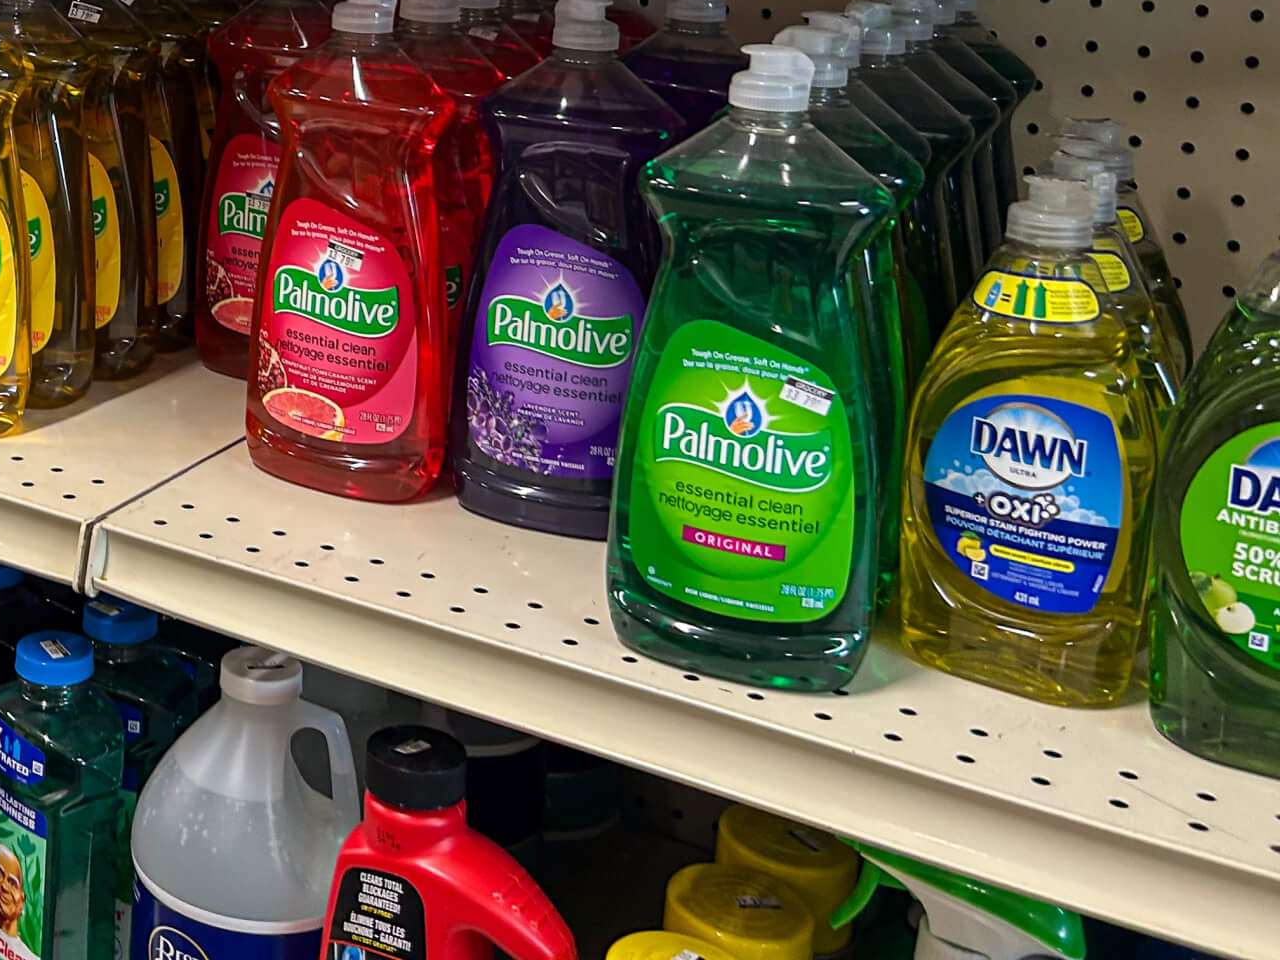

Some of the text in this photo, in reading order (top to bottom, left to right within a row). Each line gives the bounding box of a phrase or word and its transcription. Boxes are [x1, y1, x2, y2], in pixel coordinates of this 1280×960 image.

[278, 273, 396, 327] Palmolive
[286, 328, 376, 356] essential clean
[494, 303, 629, 355] Palmolive
[277, 338, 389, 373] nettoyage essentiel
[713, 351, 781, 368] On Soft On
[504, 361, 608, 387] essential clean
[553, 386, 622, 404] essentiel
[662, 411, 828, 478] Palmolive
[971, 418, 1086, 476] DAWN
[1010, 466, 1038, 479] ULTRA
[659, 491, 820, 534] nettoyage essentiel
[675, 480, 803, 516] essential clean
[990, 495, 1041, 524] OXI
[944, 505, 1066, 544] SUPERIOR STAIN FIGHTING
[944, 515, 1045, 549] POUVOIR DÉTACHANT
[694, 531, 773, 558] ORIGINAL
[5, 789, 37, 820] LASTING
[359, 871, 404, 894] CLEARS TOTAL
[362, 883, 399, 902] BLOCKAGES
[374, 919, 406, 939] TOUS LES
